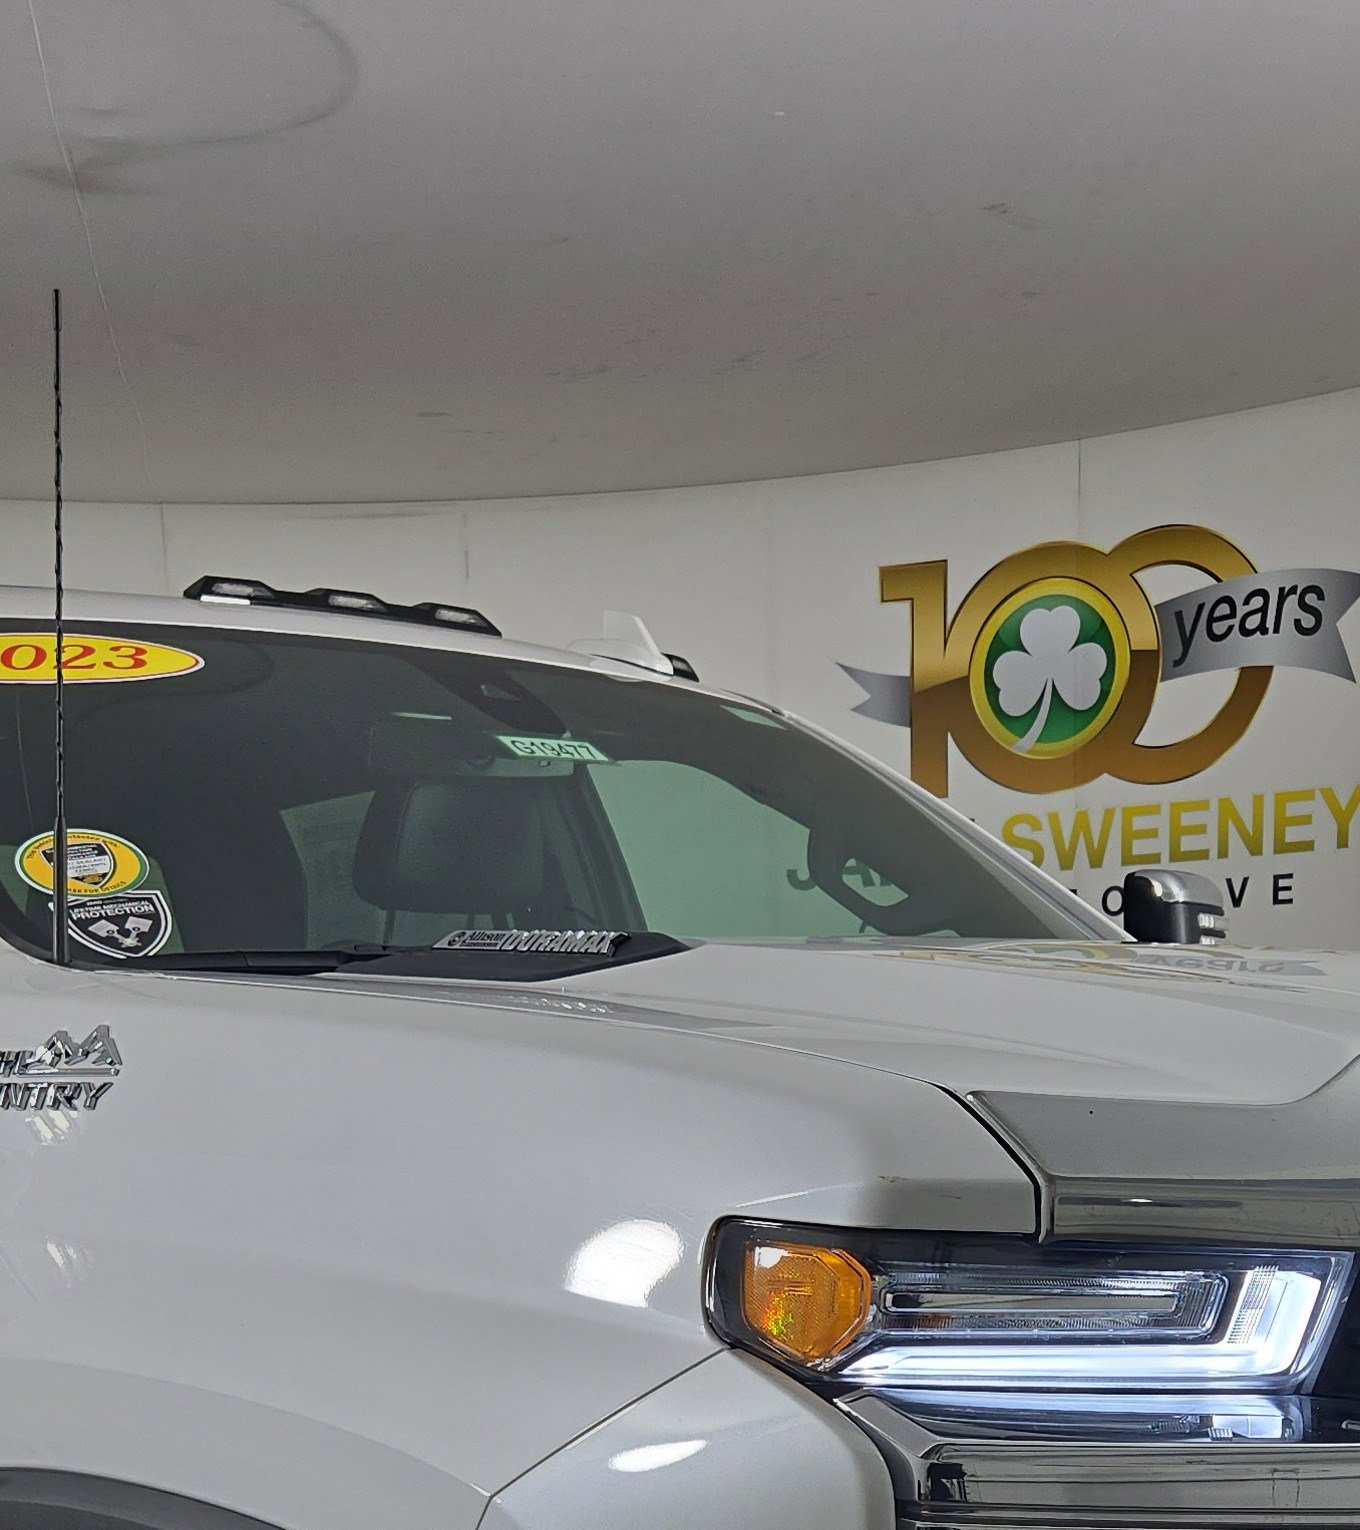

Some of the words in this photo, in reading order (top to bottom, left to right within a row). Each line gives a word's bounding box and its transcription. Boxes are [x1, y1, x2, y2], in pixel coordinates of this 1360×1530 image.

[1173, 581, 1326, 668] years
[879, 524, 1274, 799] 100
[510, 739, 598, 760] G19477
[70, 903, 155, 921] PROTECTION
[501, 929, 628, 955] DURAMAX
